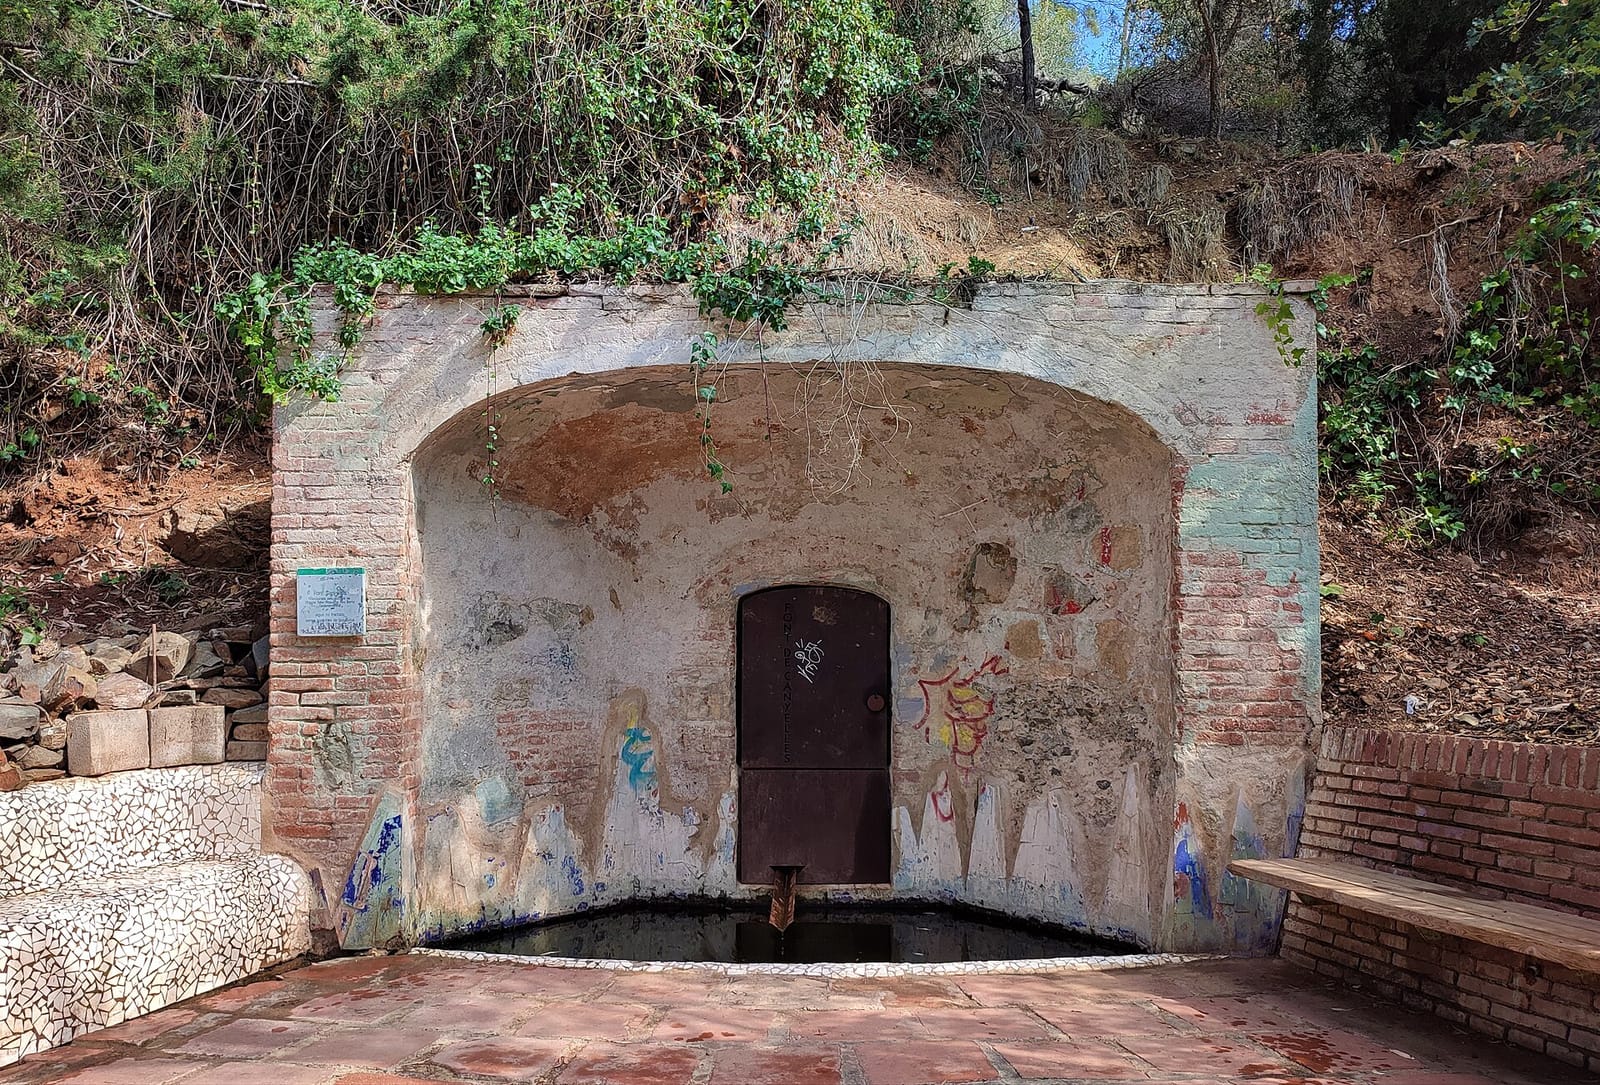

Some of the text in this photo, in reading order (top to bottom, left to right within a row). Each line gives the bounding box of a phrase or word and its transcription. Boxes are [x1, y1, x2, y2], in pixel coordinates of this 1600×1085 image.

[783, 603, 792, 763] FONT DE CANYELLES
